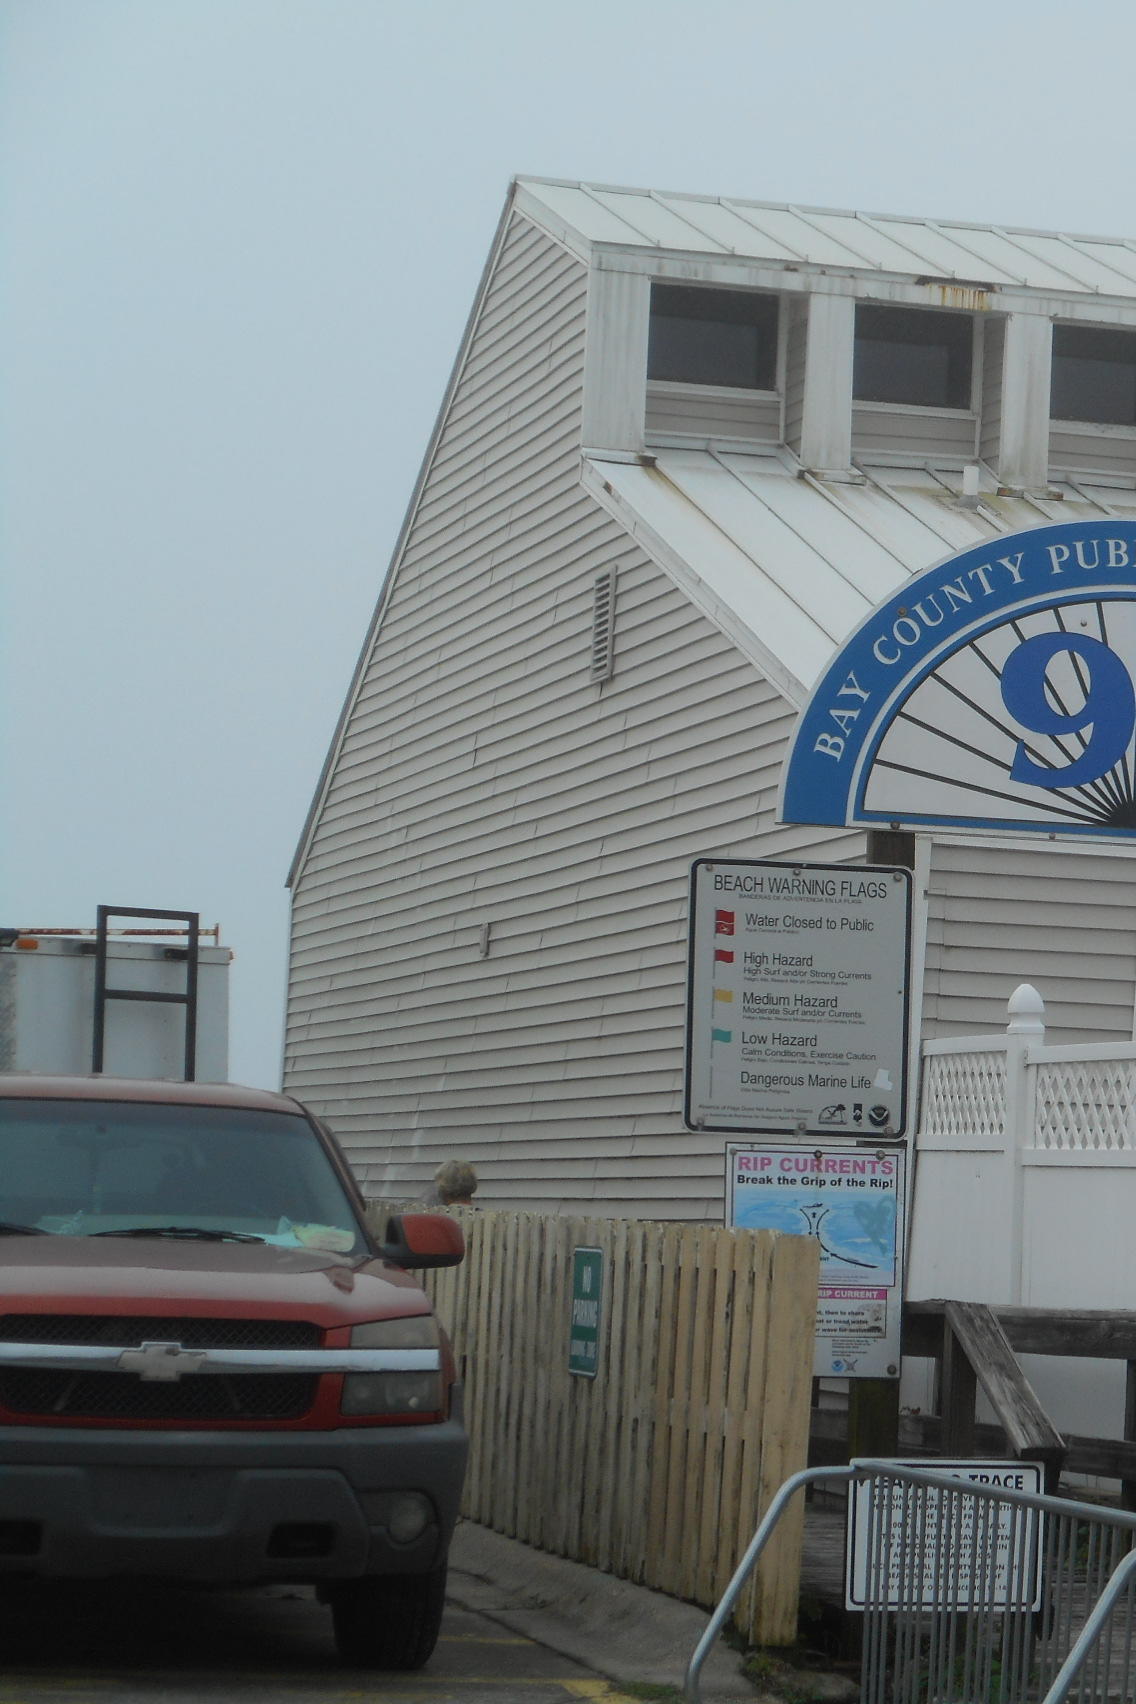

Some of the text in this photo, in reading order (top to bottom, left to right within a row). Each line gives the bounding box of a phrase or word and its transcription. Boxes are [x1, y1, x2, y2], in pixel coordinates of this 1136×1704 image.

[813, 671, 870, 762] BAY
[873, 551, 1026, 666] COUNTY
[714, 874, 887, 899] BEACH WARNING FLAGS
[745, 913, 874, 932] Water Closed to Public
[743, 952, 813, 967] High Hazard
[743, 967, 872, 980] High Surf and/or Strong Currents
[742, 992, 838, 1009] Medium Hazard
[742, 1006, 862, 1019] Moderate Surf and/or Currents
[741, 1031, 818, 1047] Low Hazard
[741, 1048, 762, 1056] Calm
[810, 1051, 843, 1060] Exercise
[845, 1052, 877, 1061] Caution
[740, 1072, 872, 1089] Dangerous Marine Life
[738, 1156, 894, 1175] RIP CURRENTS
[737, 1175, 894, 1190] Break the Grip of the Rip!
[835, 1290, 879, 1299] CURRENT
